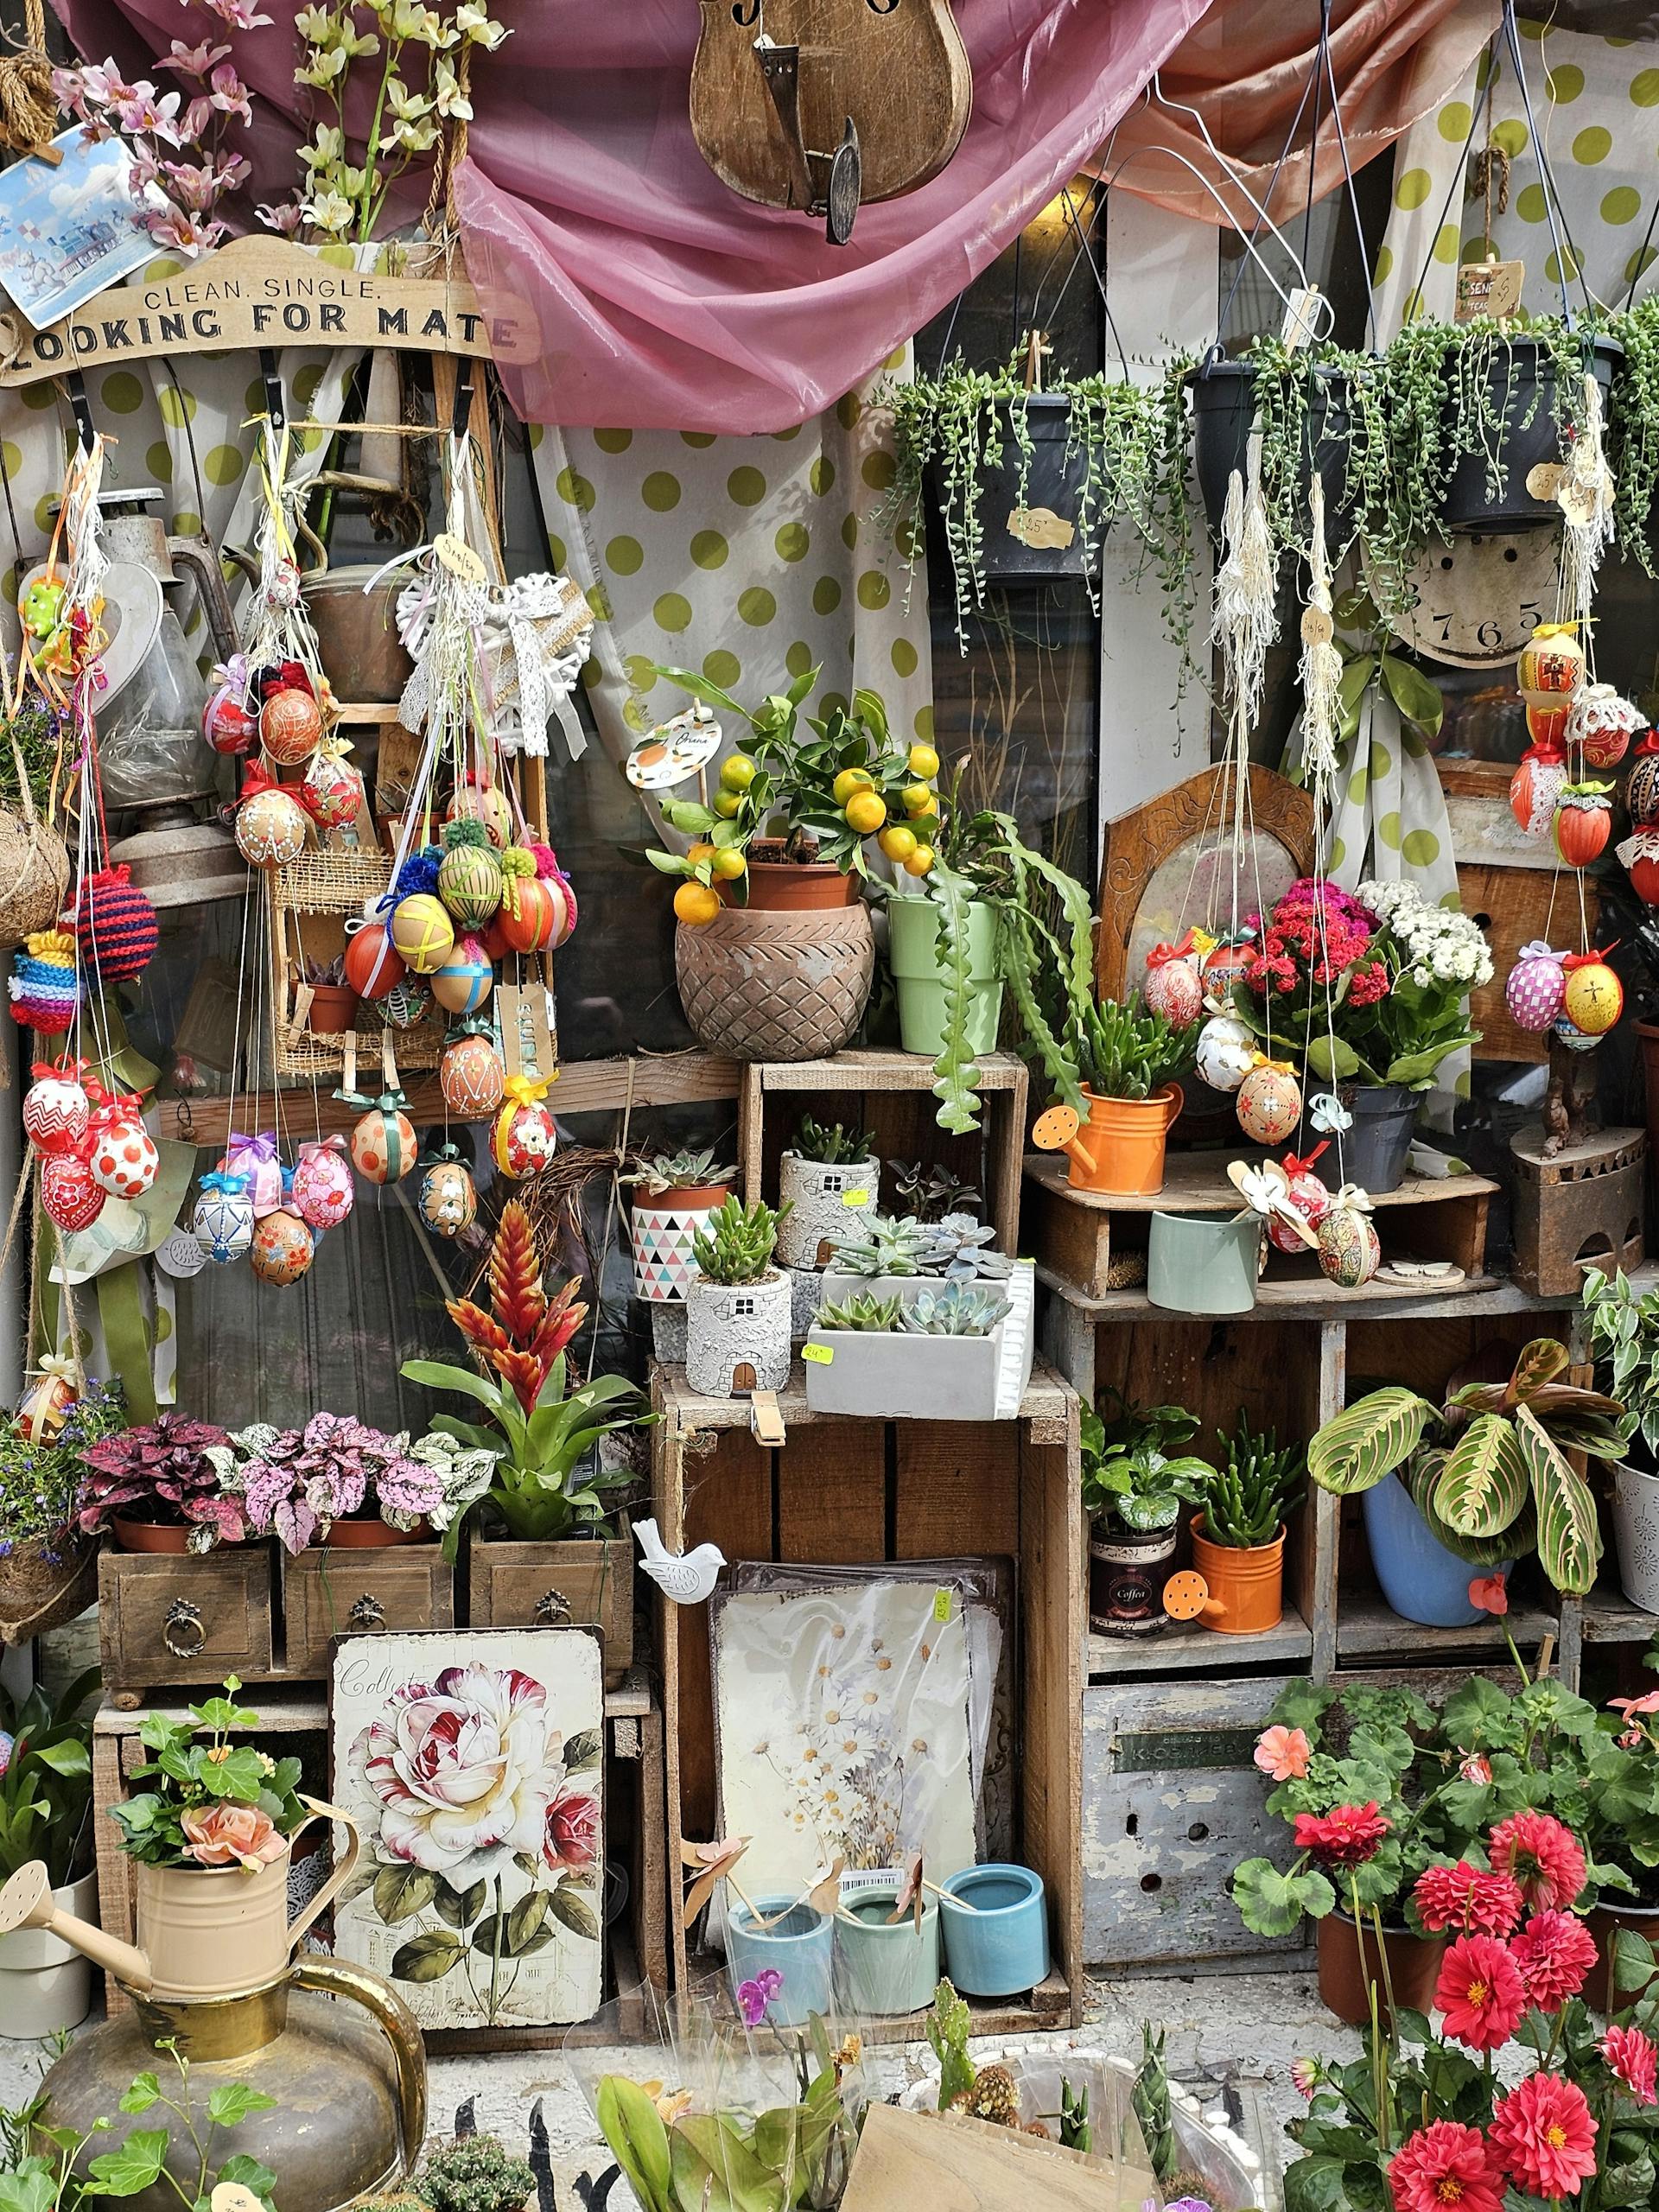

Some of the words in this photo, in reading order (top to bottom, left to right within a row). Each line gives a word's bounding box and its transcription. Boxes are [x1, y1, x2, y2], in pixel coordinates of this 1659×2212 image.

[145, 280, 250, 310] CLEAN.
[264, 278, 381, 299] SINGLE.
[252, 302, 348, 333] FOR
[378, 307, 518, 349] MATE
[1433, 613, 1454, 641] 7
[1519, 601, 1543, 630] 5
[1477, 620, 1503, 648] 6
